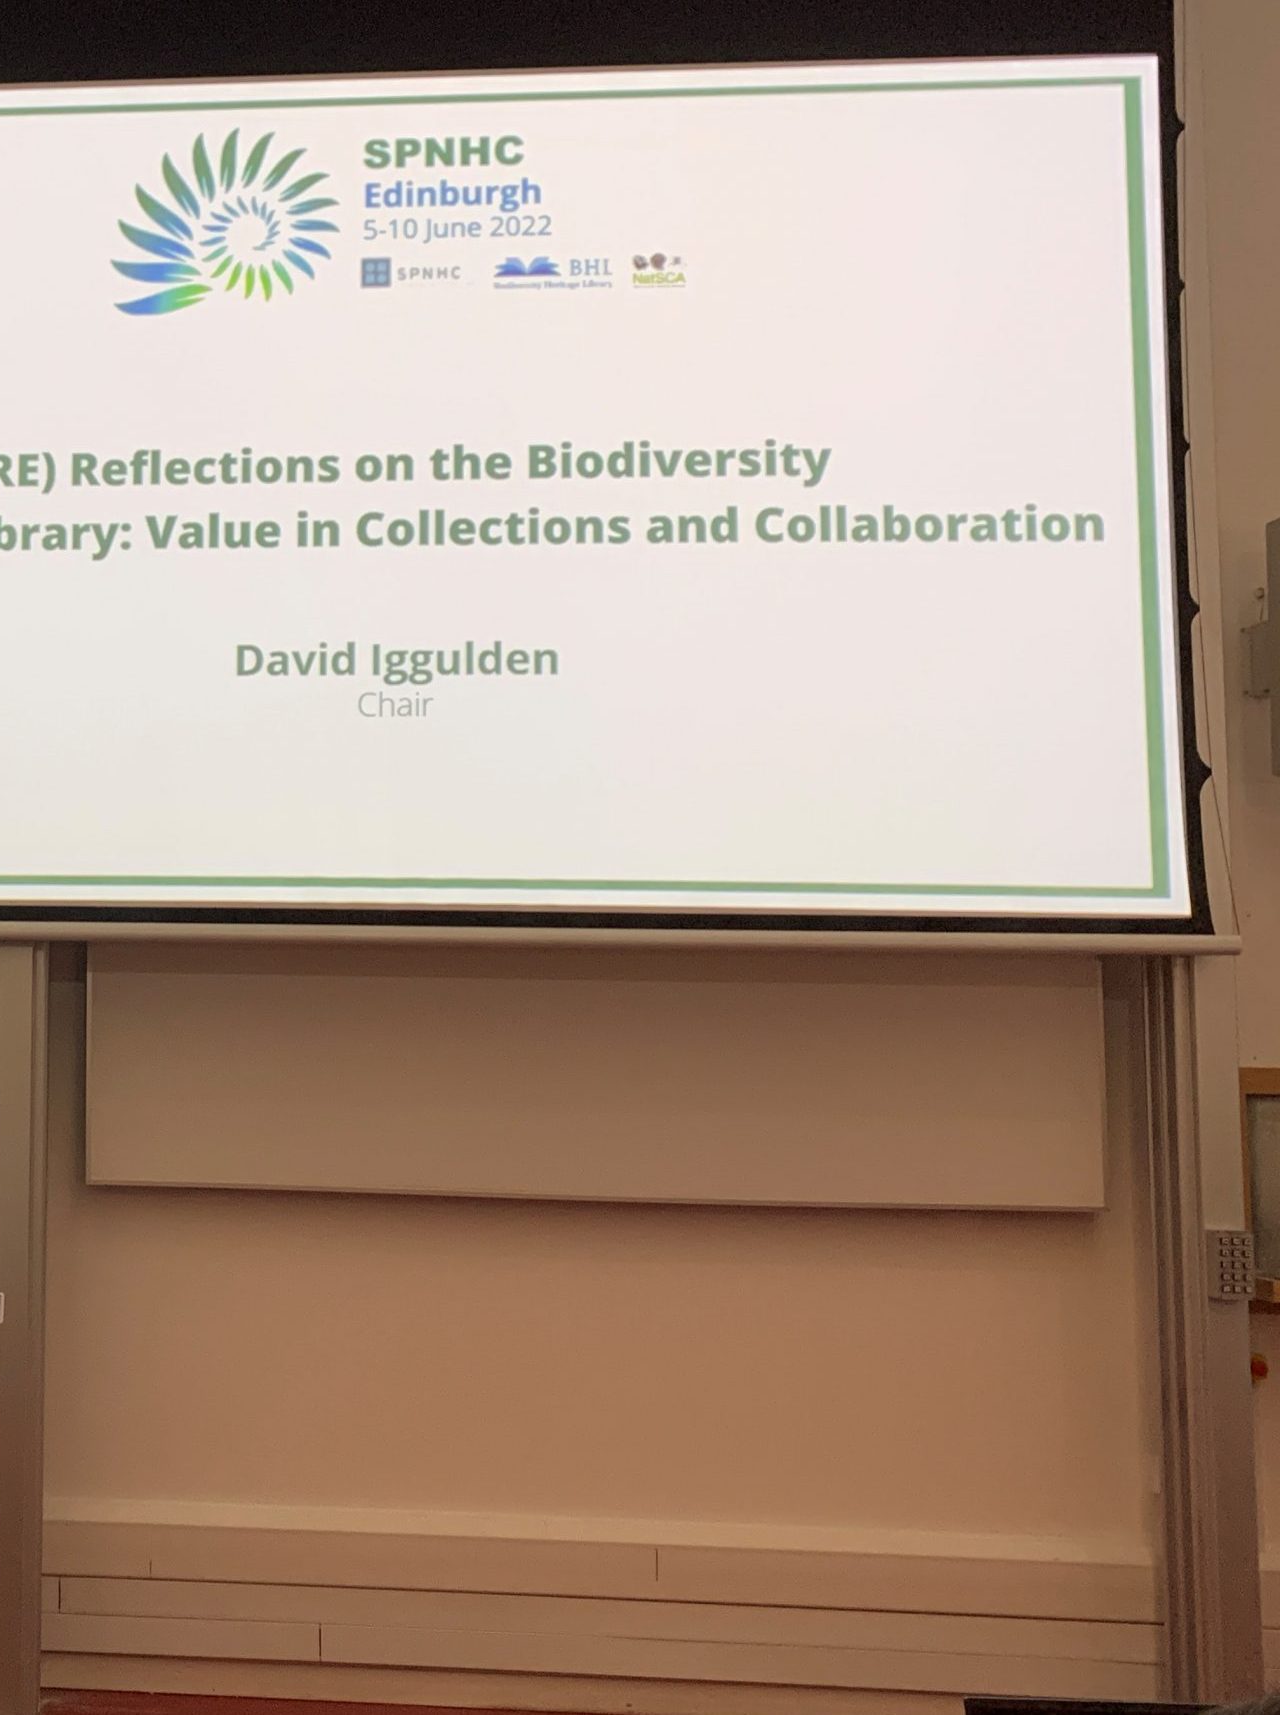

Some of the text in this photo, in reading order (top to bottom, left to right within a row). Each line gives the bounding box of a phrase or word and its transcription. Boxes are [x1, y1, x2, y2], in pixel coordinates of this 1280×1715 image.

[363, 136, 523, 169] SPNHC
[365, 177, 541, 213] Edinburgh
[364, 215, 552, 244] 5-10 June 2022
[398, 266, 460, 281] SPNHC
[570, 259, 612, 276] BHL
[632, 271, 686, 284] NatSCA
[72, 447, 340, 486] Reflections
[355, 454, 413, 482] on
[430, 444, 511, 481] the
[529, 439, 831, 487] Biodiversity
[145, 513, 280, 549] Value
[297, 511, 339, 547] in
[356, 507, 630, 547] Collections
[647, 506, 738, 544] and
[755, 504, 1104, 543] Collaboration
[237, 641, 558, 685] David Iggulden
[358, 691, 434, 717] Chair
